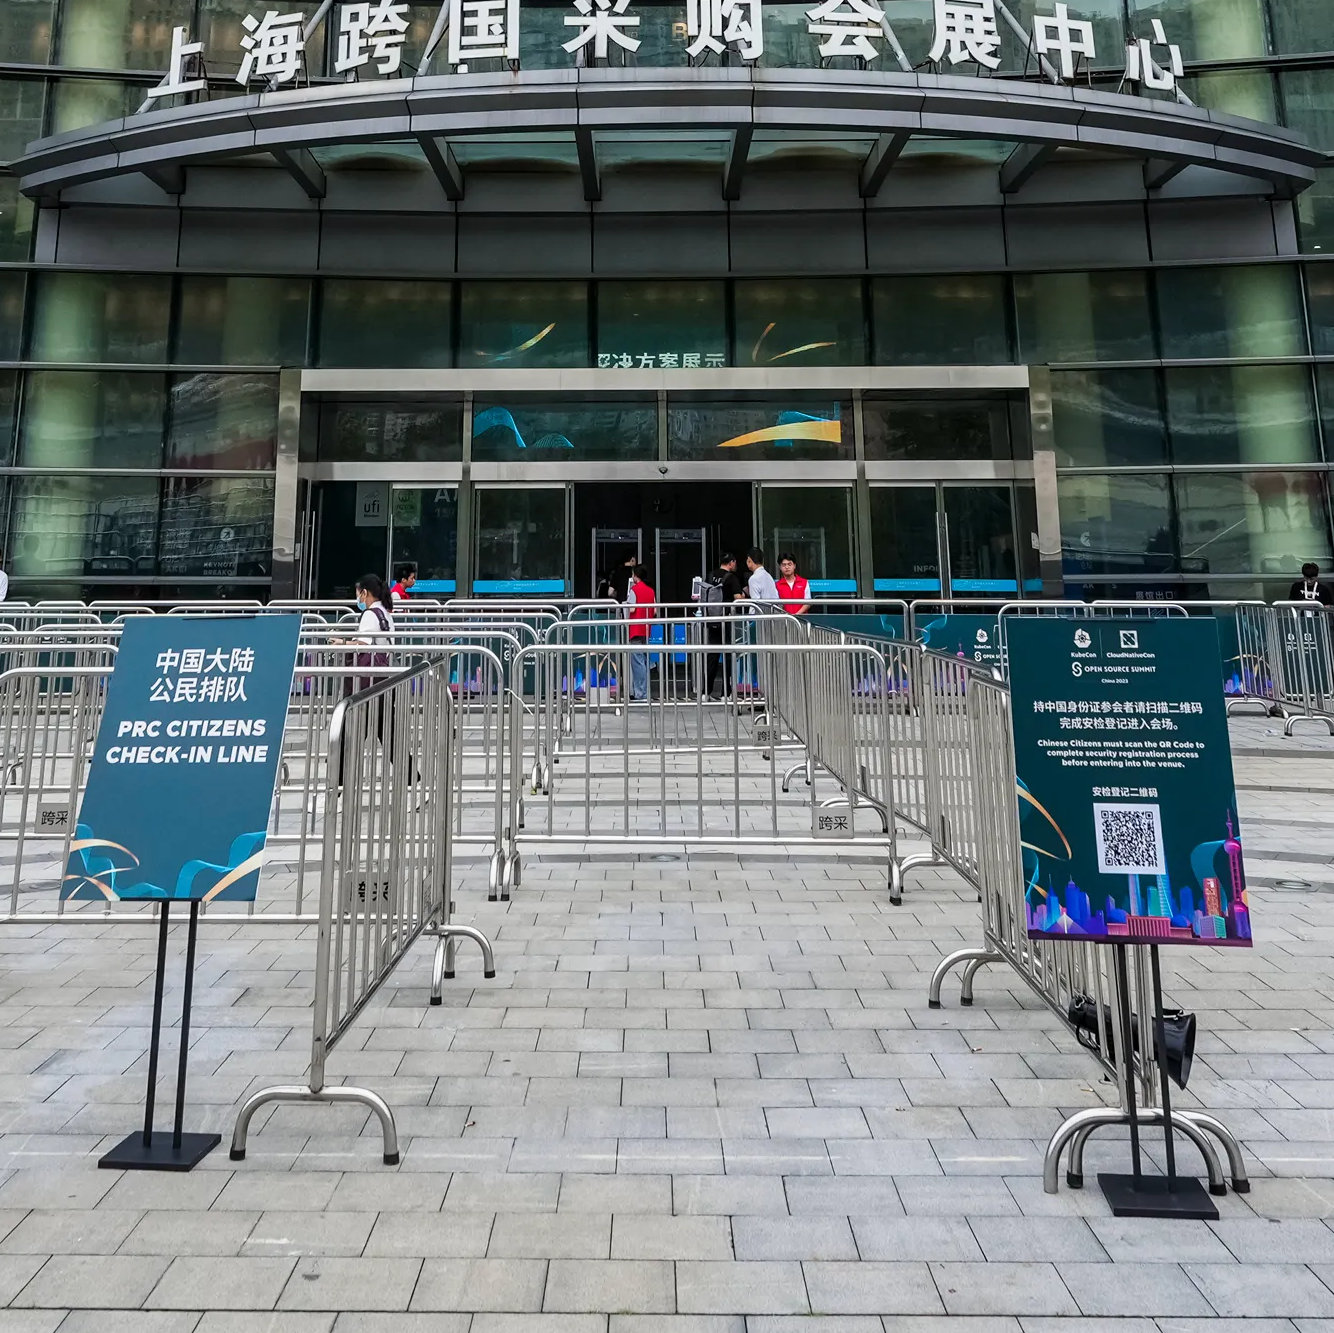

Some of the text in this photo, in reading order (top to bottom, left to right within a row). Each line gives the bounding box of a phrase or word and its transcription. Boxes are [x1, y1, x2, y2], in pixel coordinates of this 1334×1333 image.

[363, 499, 380, 513] ufi
[155, 647, 255, 675] 中国大陆
[149, 675, 248, 703] 公民排队
[1033, 700, 1203, 714] 持中国身份证参会者请扫描二维码
[117, 719, 267, 738] PRC CITIZENS
[1059, 717, 1179, 731] 完成安检登记进入会场。
[1037, 739, 1068, 747] Chinese
[1069, 739, 1102, 748] Citizens
[1158, 741, 1172, 749] QR
[1173, 741, 1194, 749] Code
[105, 745, 269, 764] CHECK-IN LINE
[1047, 749, 1199, 760] complete security registration process
[1061, 758, 1088, 766] before
[1089, 759, 1124, 768] entering
[1125, 759, 1142, 767] into
[1157, 760, 1186, 768] venue.
[1092, 786, 1159, 798] 安检登记二维码
[41, 810, 69, 826] 跨采
[818, 815, 849, 831] 跨采
